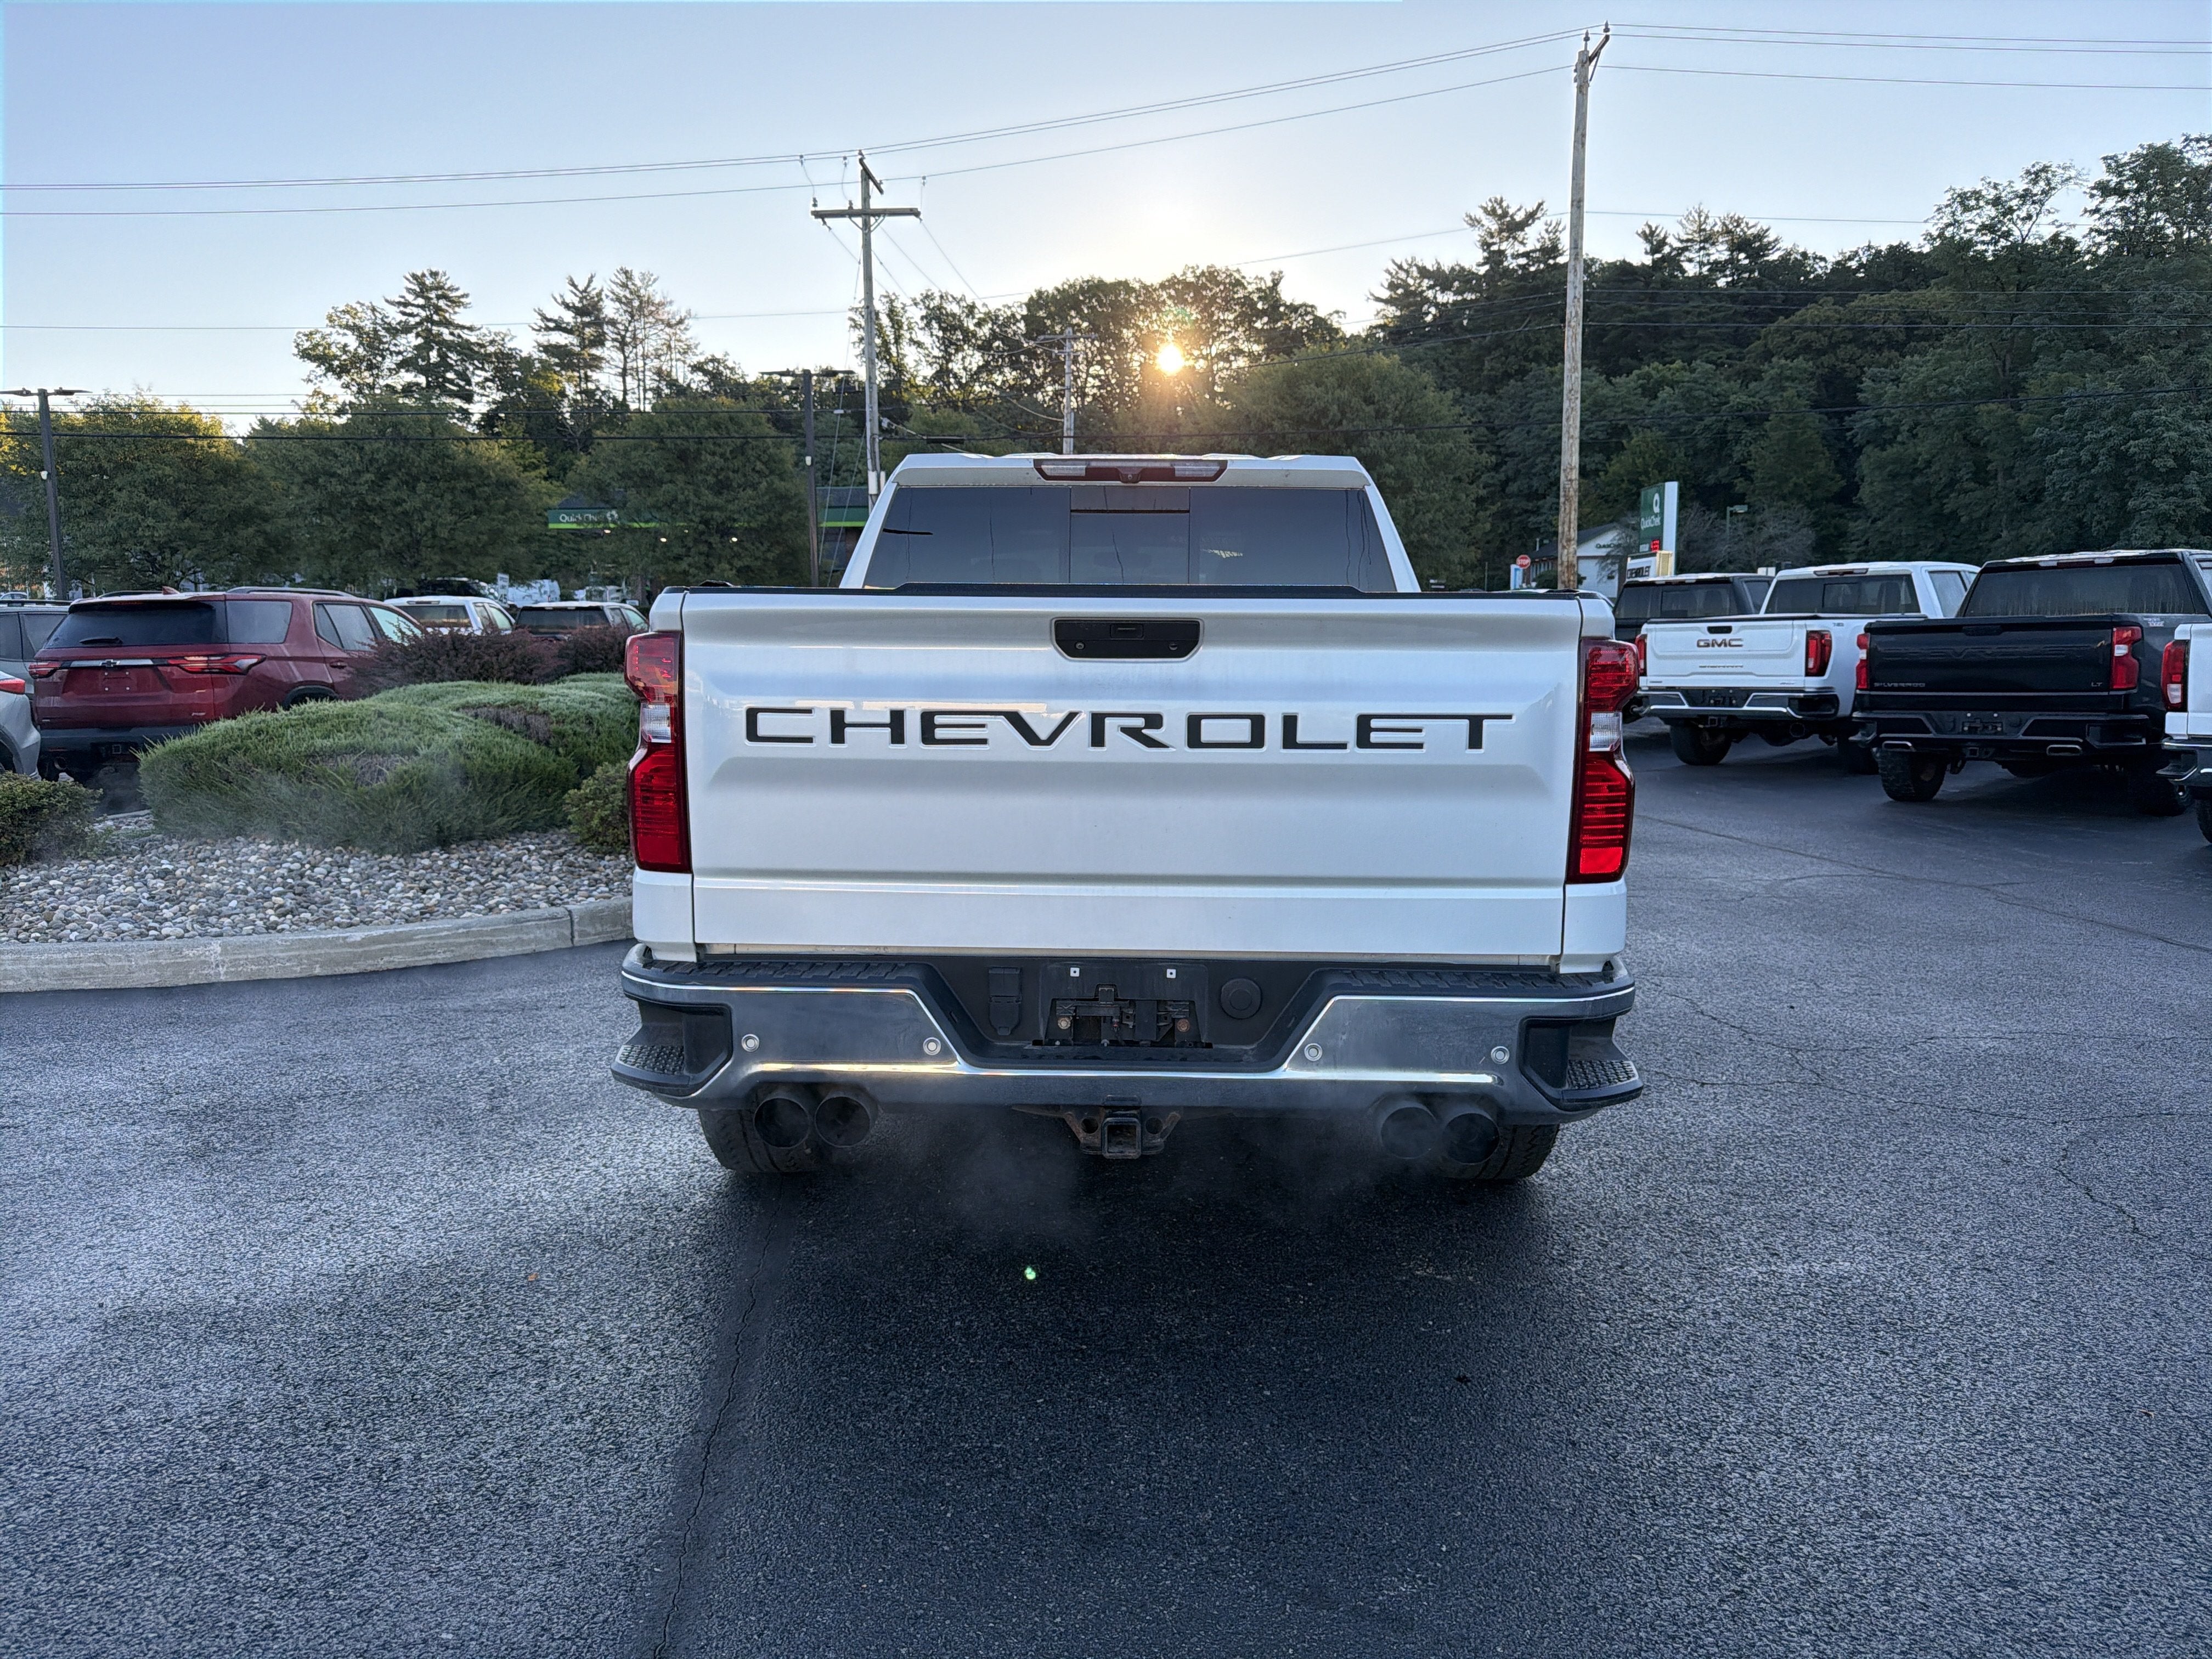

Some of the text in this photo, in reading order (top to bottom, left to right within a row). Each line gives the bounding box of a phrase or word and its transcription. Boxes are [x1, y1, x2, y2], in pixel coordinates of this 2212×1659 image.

[499, 594, 507, 604] 45
[1696, 638, 1743, 648] GMC
[745, 707, 1514, 751] CHEVROLET
